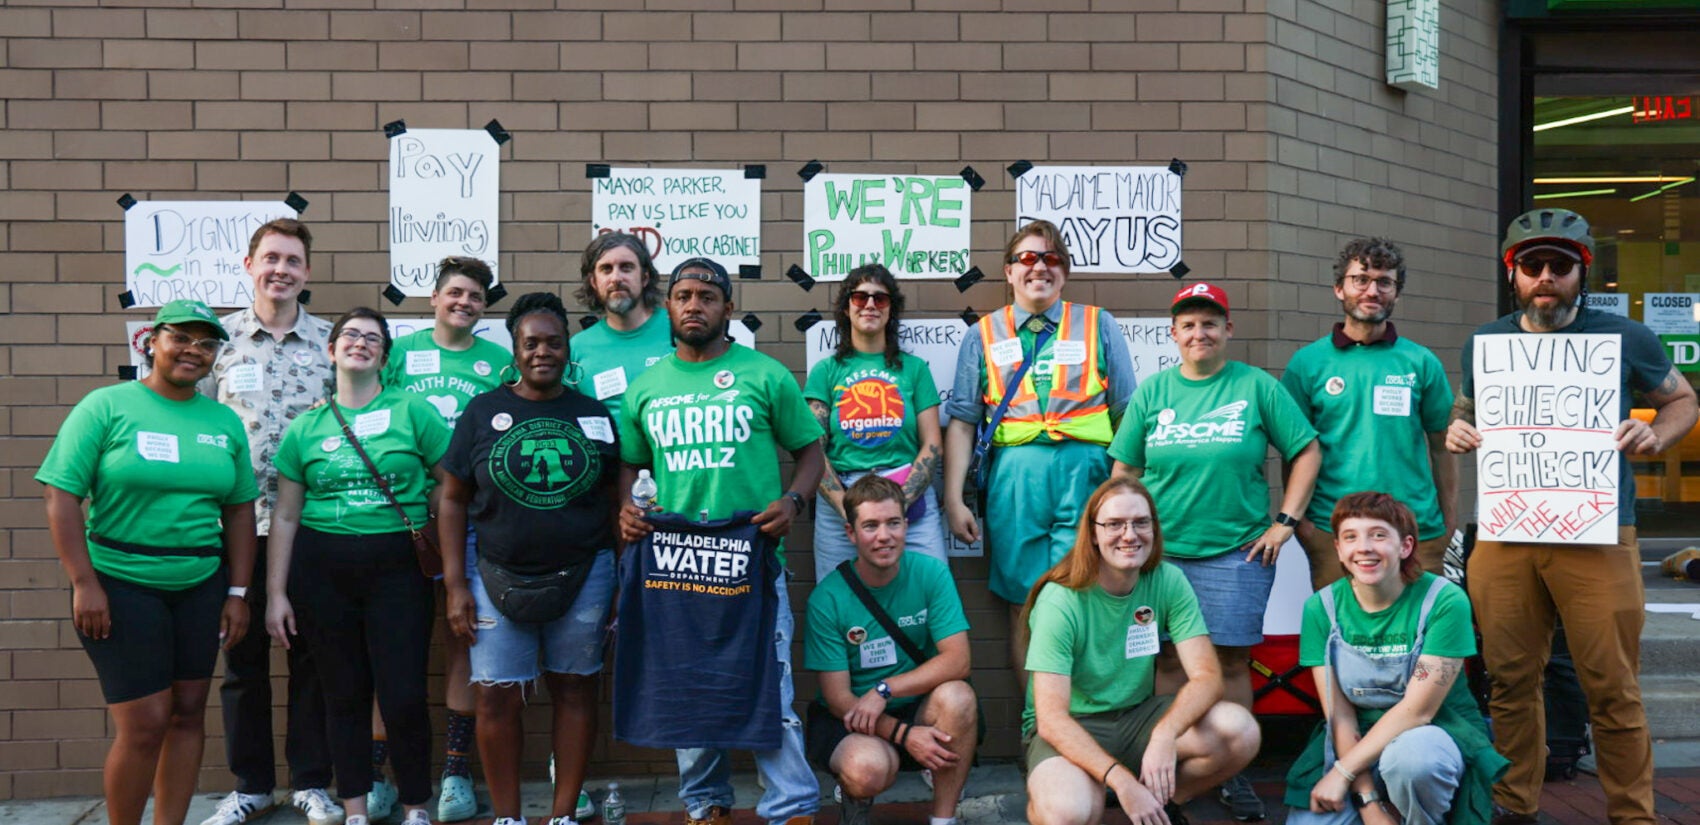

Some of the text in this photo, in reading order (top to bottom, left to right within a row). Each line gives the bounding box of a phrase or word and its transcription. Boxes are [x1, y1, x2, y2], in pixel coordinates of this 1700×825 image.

[598, 176, 726, 195] MAYOR PARKER,
[1020, 173, 1111, 212] MADAME
[608, 202, 748, 221] PAY US LIKE YOU
[825, 177, 964, 228] WE'RE
[392, 206, 489, 255] living
[662, 237, 703, 256] YOUR
[1115, 214, 1180, 269] US
[184, 257, 240, 276] in the
[1586, 296, 1619, 307] ERRADO
[1651, 296, 1692, 308] CLOSED
[1482, 337, 1617, 375] LIVING
[1667, 341, 1700, 365] TD
[845, 369, 897, 385] AFSCME
[648, 392, 711, 410] AFSCME for
[1478, 385, 1616, 429] CHECK
[647, 404, 754, 448] HARRIS
[840, 415, 903, 431] organize
[1148, 421, 1245, 442] AFSCME
[852, 431, 892, 440] for power
[1518, 432, 1546, 448] TO
[664, 447, 736, 472] WALZ
[1479, 450, 1616, 489] CHECK
[1480, 491, 1615, 540] WHAT THE HECK
[652, 531, 752, 552] PHILADELPHIA
[652, 545, 750, 578] WATER
[670, 572, 730, 584] DEPARTMENT
[644, 579, 752, 597] SAFETY IS NO ACCIDENT
[862, 639, 892, 651] WE RUN
[870, 648, 886, 656] THIS
